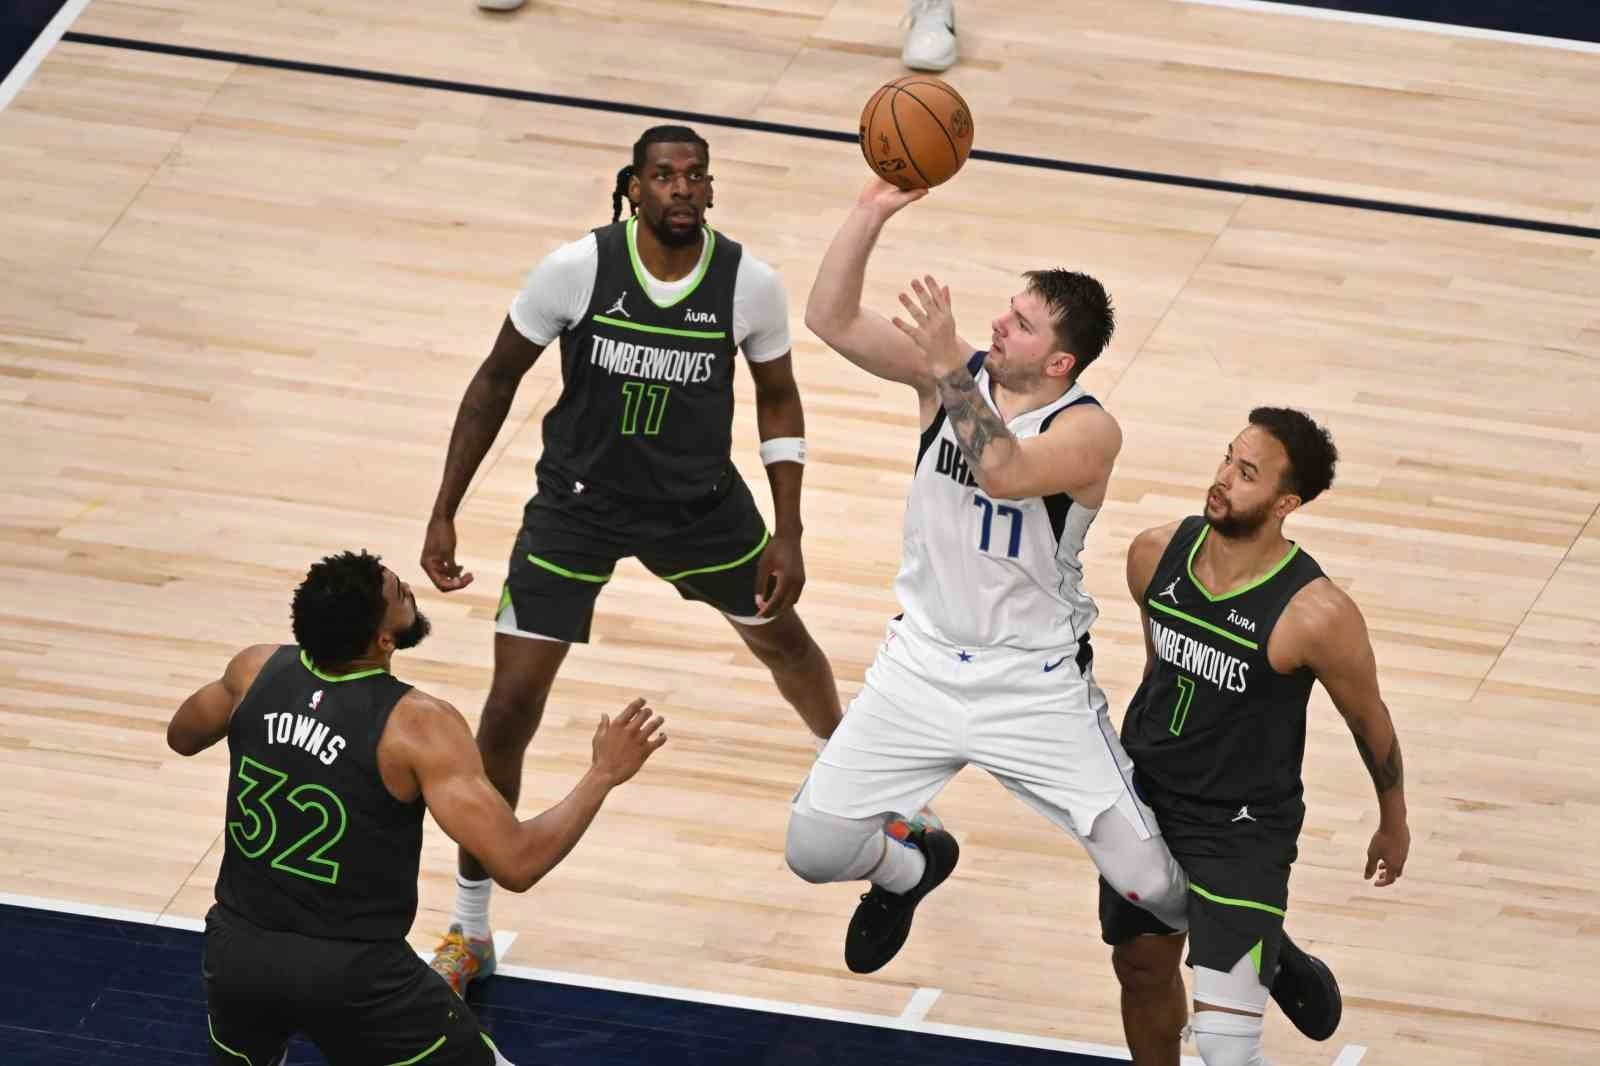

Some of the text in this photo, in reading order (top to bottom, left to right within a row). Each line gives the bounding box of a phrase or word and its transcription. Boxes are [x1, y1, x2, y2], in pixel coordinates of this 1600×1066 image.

[590, 334, 716, 388] TIMBERWOLVES
[621, 381, 670, 435] 11
[973, 494, 1024, 559] 77
[263, 711, 347, 766] TOWNS
[228, 755, 347, 885] 32
